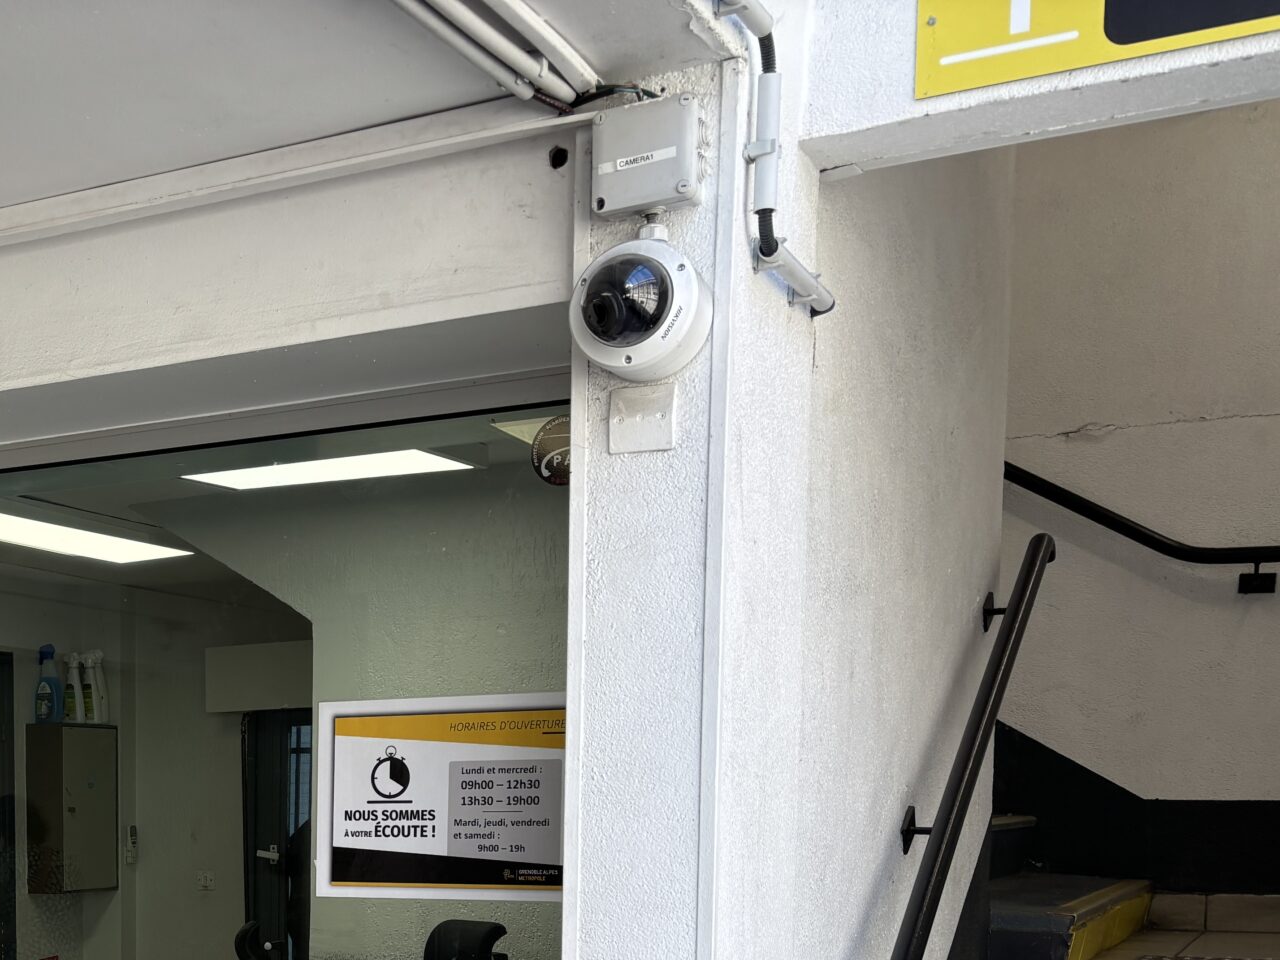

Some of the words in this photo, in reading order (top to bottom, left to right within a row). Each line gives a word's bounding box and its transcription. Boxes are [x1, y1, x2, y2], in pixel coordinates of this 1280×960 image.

[618, 154, 654, 168] CAMERA1
[662, 306, 683, 340] HIKVISION
[449, 721, 497, 732] HORAIRES
[461, 766, 484, 774] Lundi
[498, 766, 537, 774] mercredi
[461, 780, 494, 790] 09h00
[506, 779, 540, 789] 12h30
[461, 796, 493, 806] 13h30
[506, 796, 540, 805] 19h00
[344, 810, 378, 821] NOUS
[382, 809, 436, 821] SOMMES
[454, 819, 481, 828] Mardi,
[484, 819, 508, 828] jeudi,
[510, 818, 550, 827] vendredi
[344, 829, 349, 838] À
[374, 821, 428, 838] ÉCOUTE
[464, 831, 495, 839] samedi
[477, 844, 499, 852] 9h00
[509, 844, 526, 852] 19h
